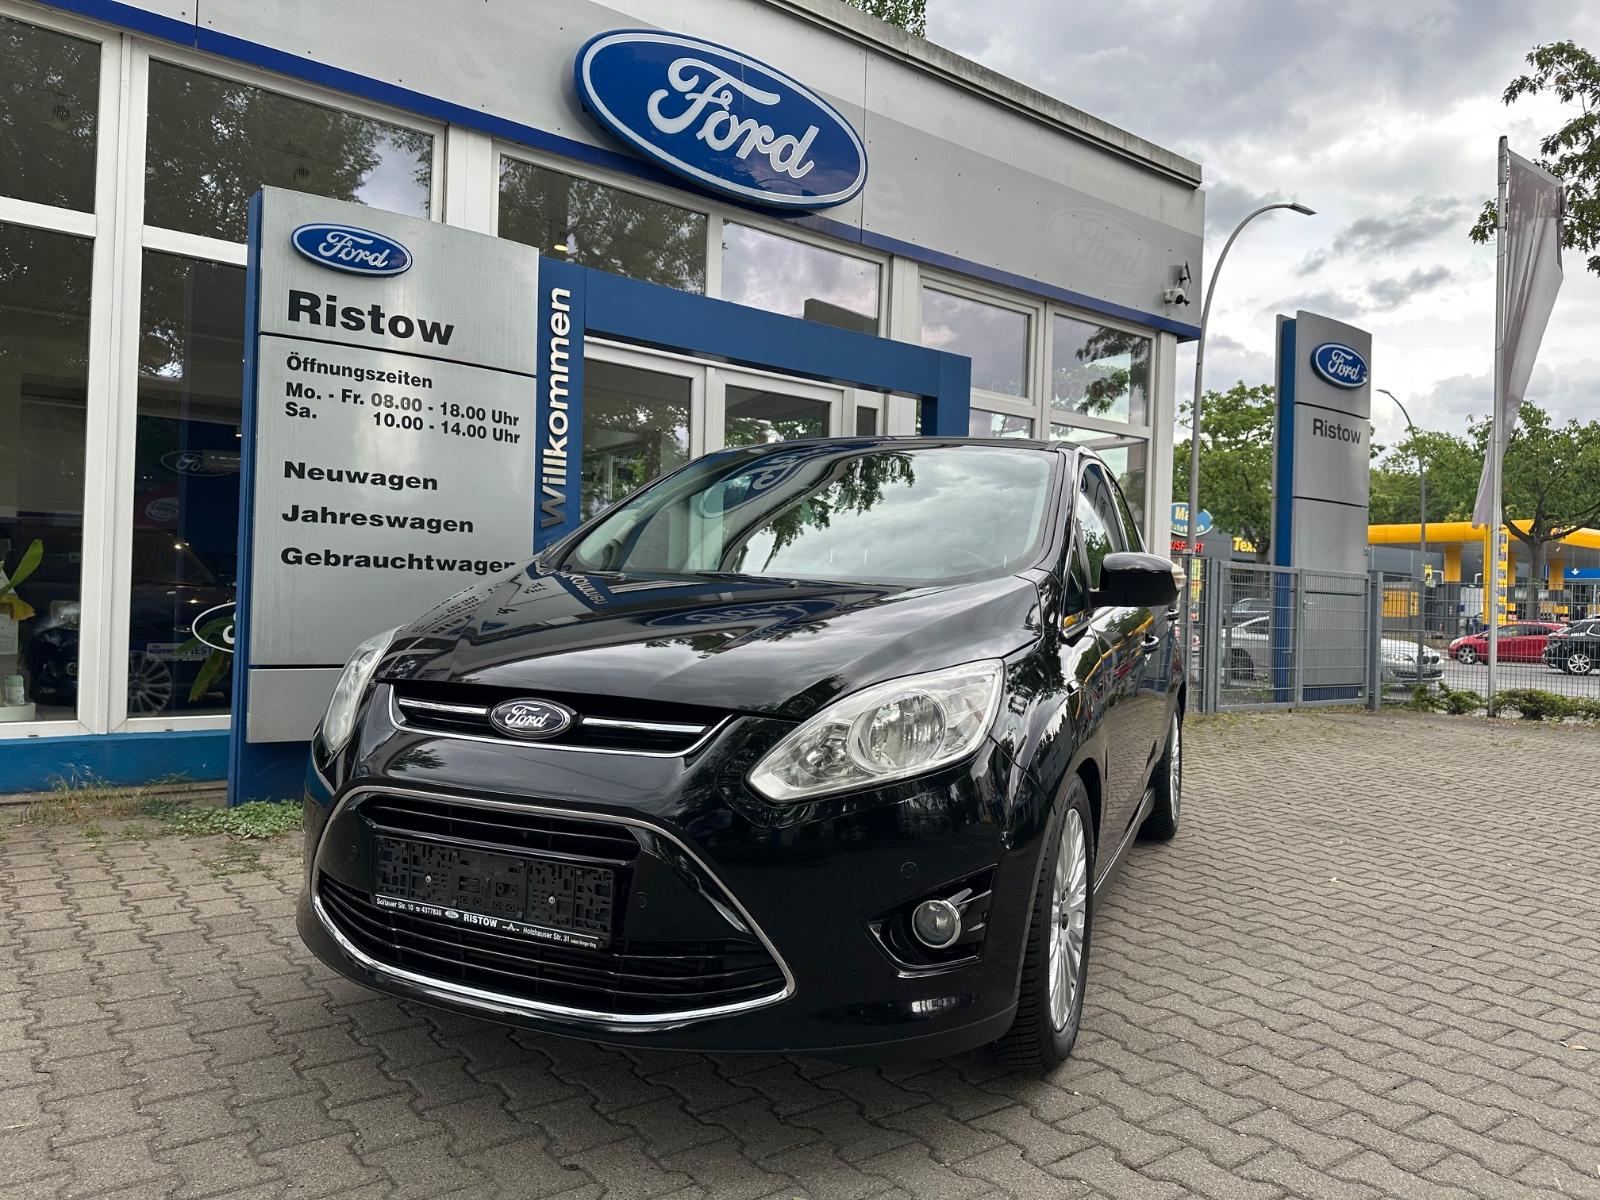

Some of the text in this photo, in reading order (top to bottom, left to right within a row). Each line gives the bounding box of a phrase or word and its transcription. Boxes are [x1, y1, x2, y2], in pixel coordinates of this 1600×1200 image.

[647, 57, 818, 180] Ford
[318, 231, 389, 268] Ford
[287, 289, 455, 346] Ristow
[286, 352, 433, 389] Öffnungszeiten
[1327, 349, 1360, 380] Ford
[285, 381, 322, 400] Mo.
[341, 389, 365, 405] Fr.
[371, 392, 423, 412] 08.00
[440, 401, 486, 422] 18.00
[491, 408, 519, 427] Uhr
[541, 287, 570, 528] Willkommen
[285, 401, 317, 419] Sa.
[373, 412, 424, 431] 10.00
[441, 420, 487, 440] 14.00
[492, 427, 520, 444] Uhr
[1312, 418, 1361, 444] Ristow
[284, 461, 438, 490] Neuwagen
[282, 505, 474, 534] Jahreswagen
[505, 704, 550, 727] Ford
[463, 913, 498, 928] RISTOW
[523, 926, 552, 939] Holzhauser
[553, 932, 563, 941] Str.
